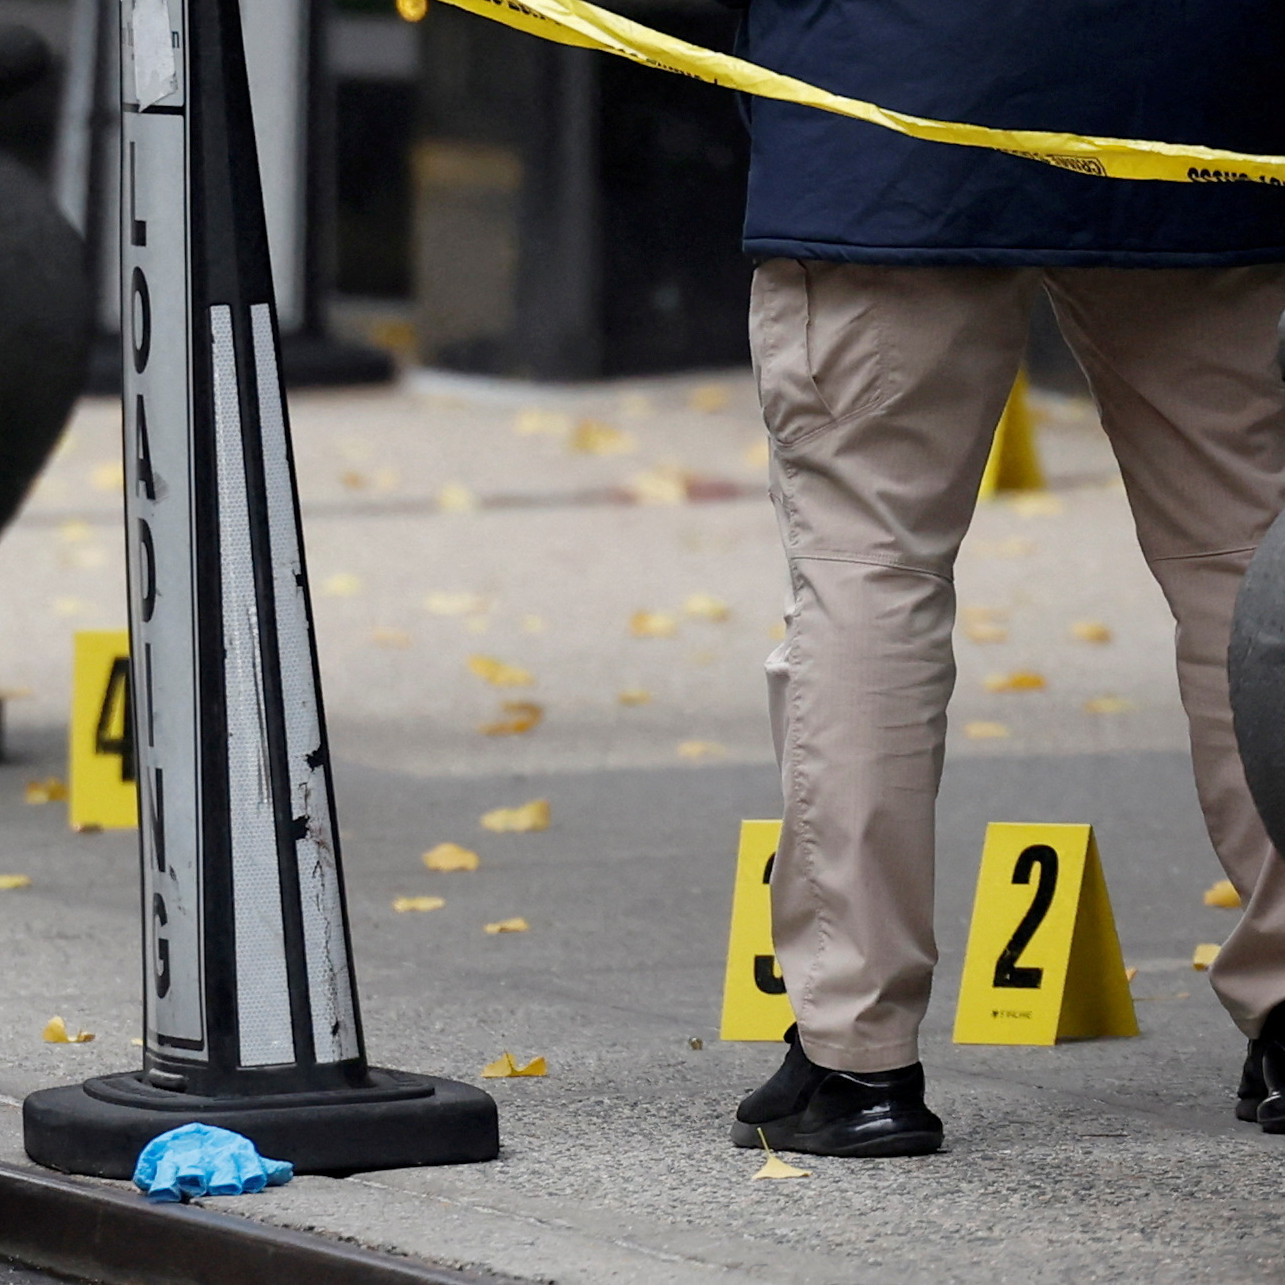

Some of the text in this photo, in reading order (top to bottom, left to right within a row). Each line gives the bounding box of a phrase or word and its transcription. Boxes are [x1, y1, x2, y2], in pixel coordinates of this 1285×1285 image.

[129, 141, 171, 1000] LOADING
[95, 655, 137, 783] 4
[992, 844, 1059, 989] 2
